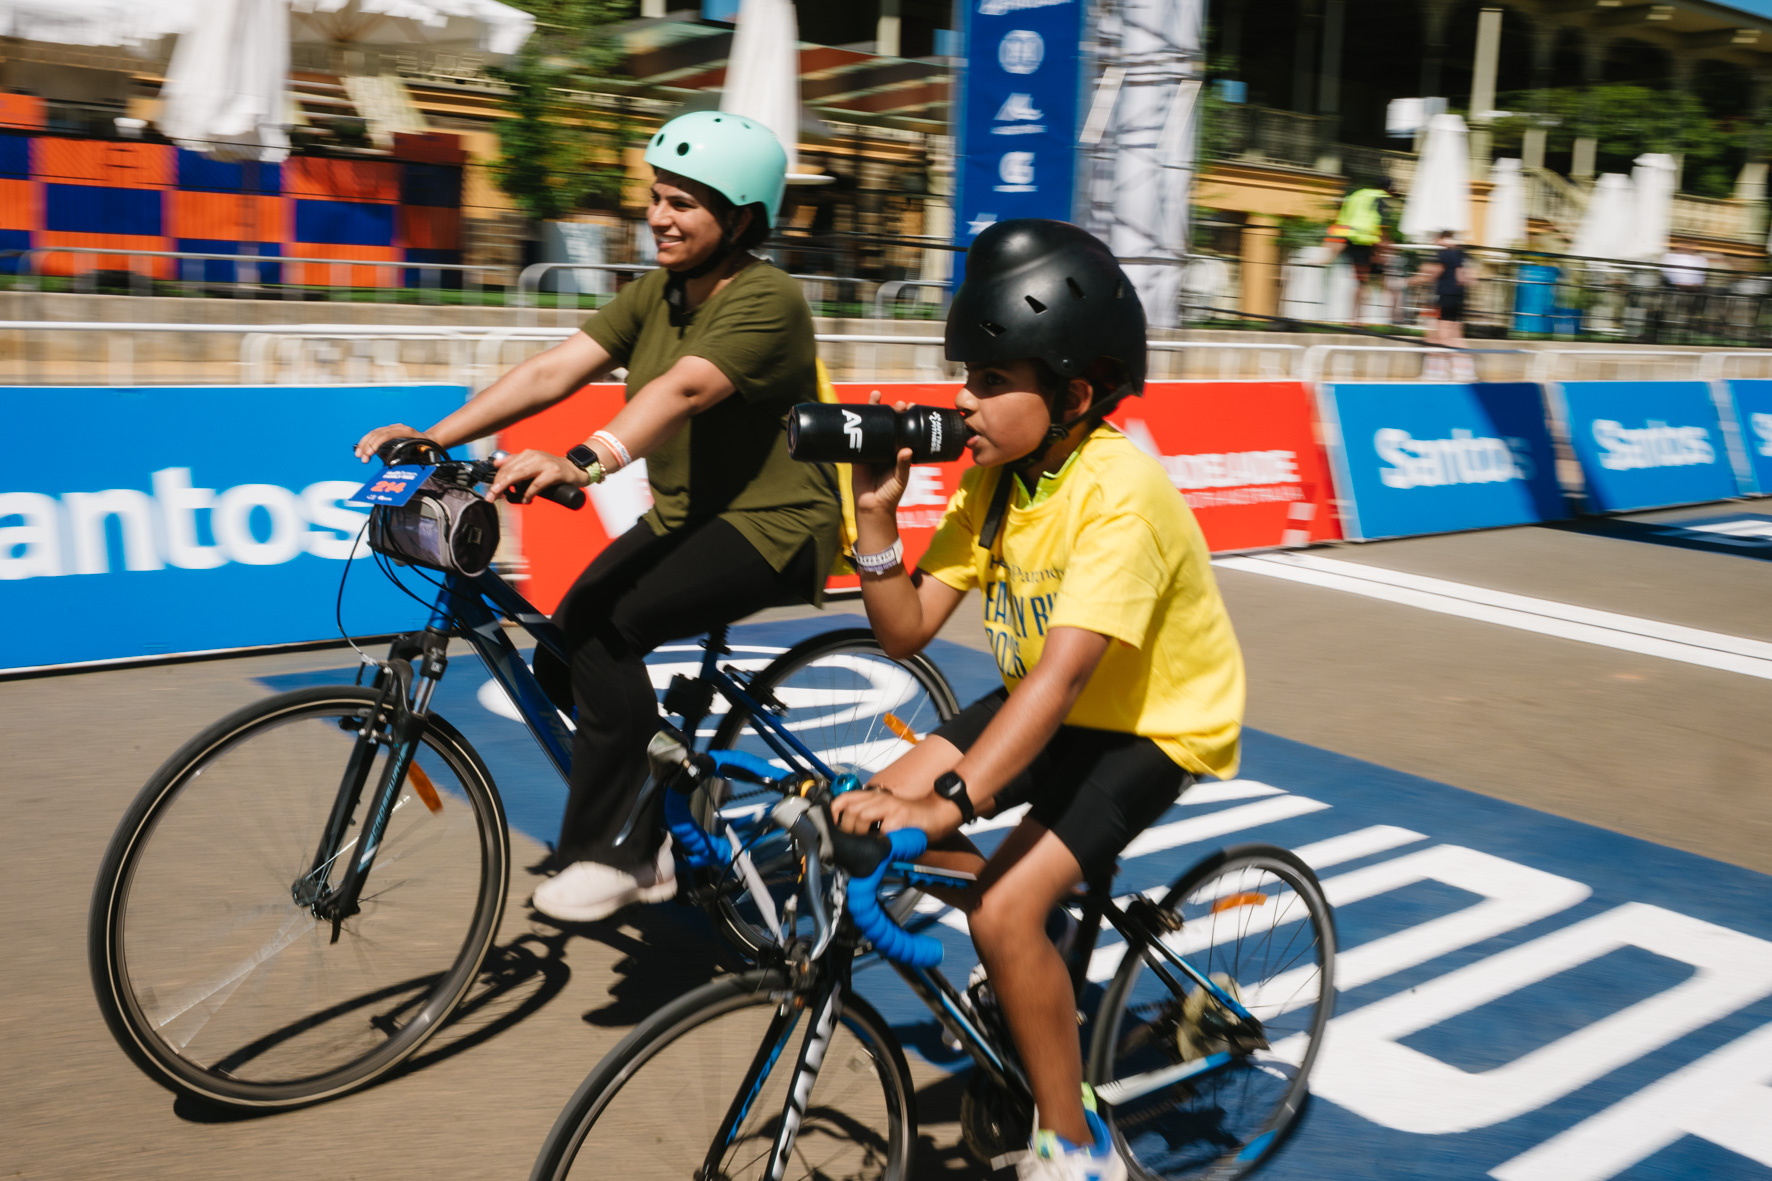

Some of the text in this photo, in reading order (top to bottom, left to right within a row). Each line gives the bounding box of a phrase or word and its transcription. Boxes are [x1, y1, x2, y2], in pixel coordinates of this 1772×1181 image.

[841, 409, 863, 451] AF
[1591, 418, 1715, 471] Santos
[1373, 427, 1537, 489] Santos
